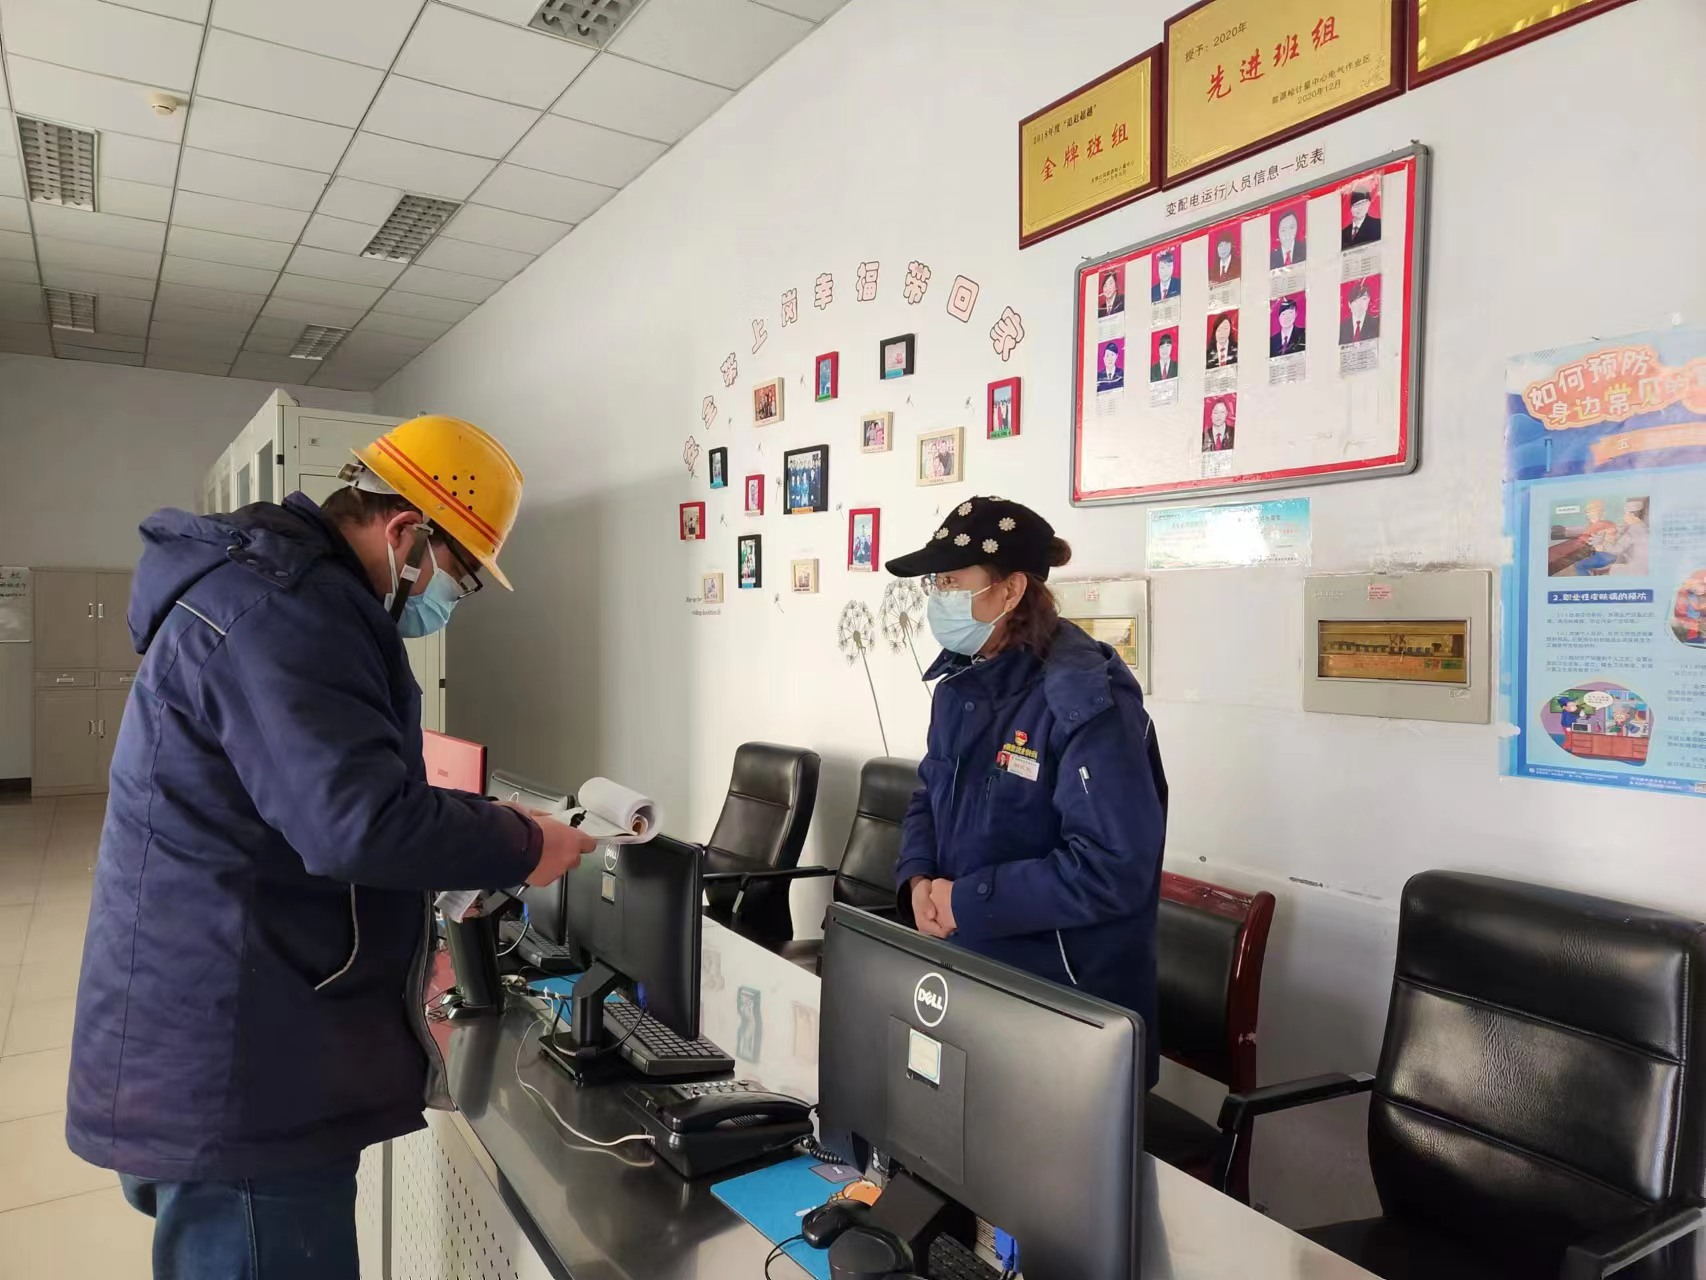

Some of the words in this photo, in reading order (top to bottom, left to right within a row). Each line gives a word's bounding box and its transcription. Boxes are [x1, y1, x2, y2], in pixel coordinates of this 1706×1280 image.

[1206, 16, 1340, 103] 先进班组
[1040, 121, 1129, 184] 金牌班组
[1165, 147, 1325, 217] 变配电运行人员信息一览表
[1528, 350, 1651, 411] 如何预防
[917, 987, 943, 1011] DELL
